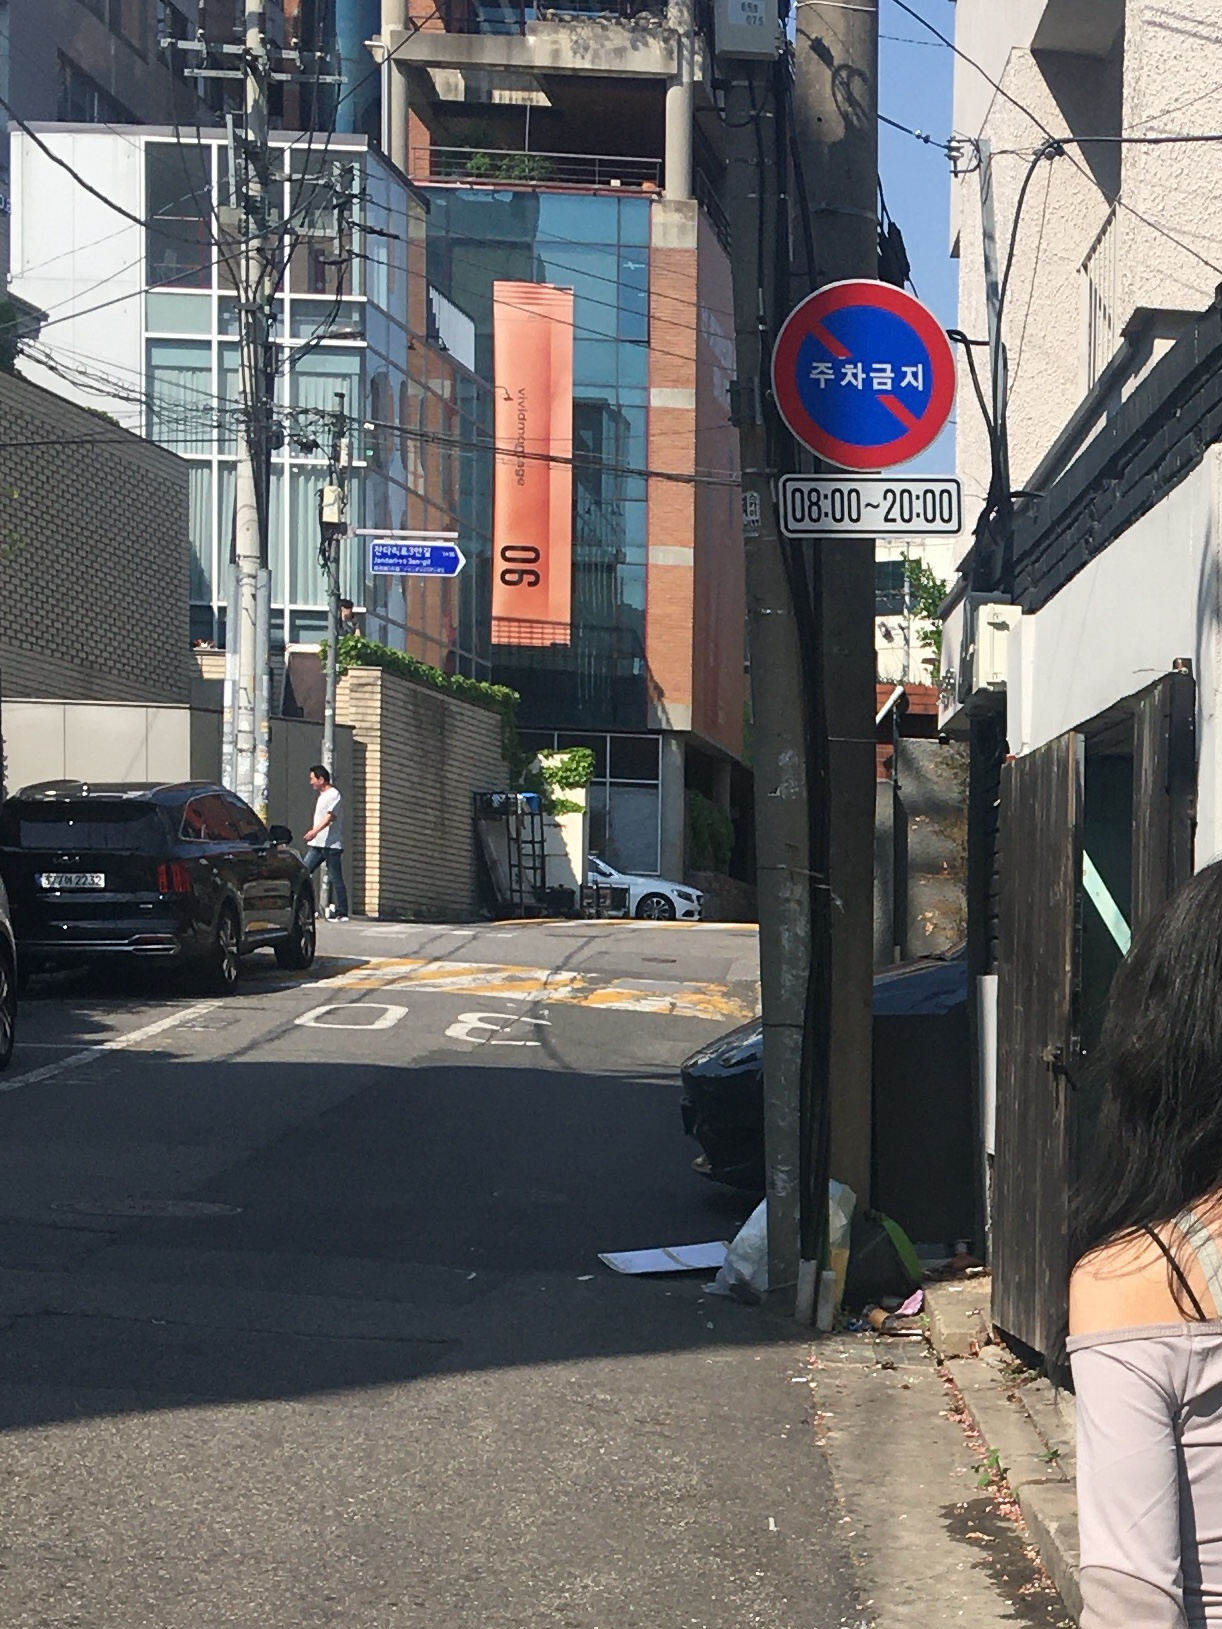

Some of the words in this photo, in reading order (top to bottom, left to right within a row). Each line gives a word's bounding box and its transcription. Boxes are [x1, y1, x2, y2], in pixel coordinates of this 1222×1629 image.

[809, 356, 924, 391] 주차금지
[790, 487, 954, 524] 08:00~20:00
[373, 545, 432, 558] 잔다리로3안길
[75, 874, 102, 886] 2232
